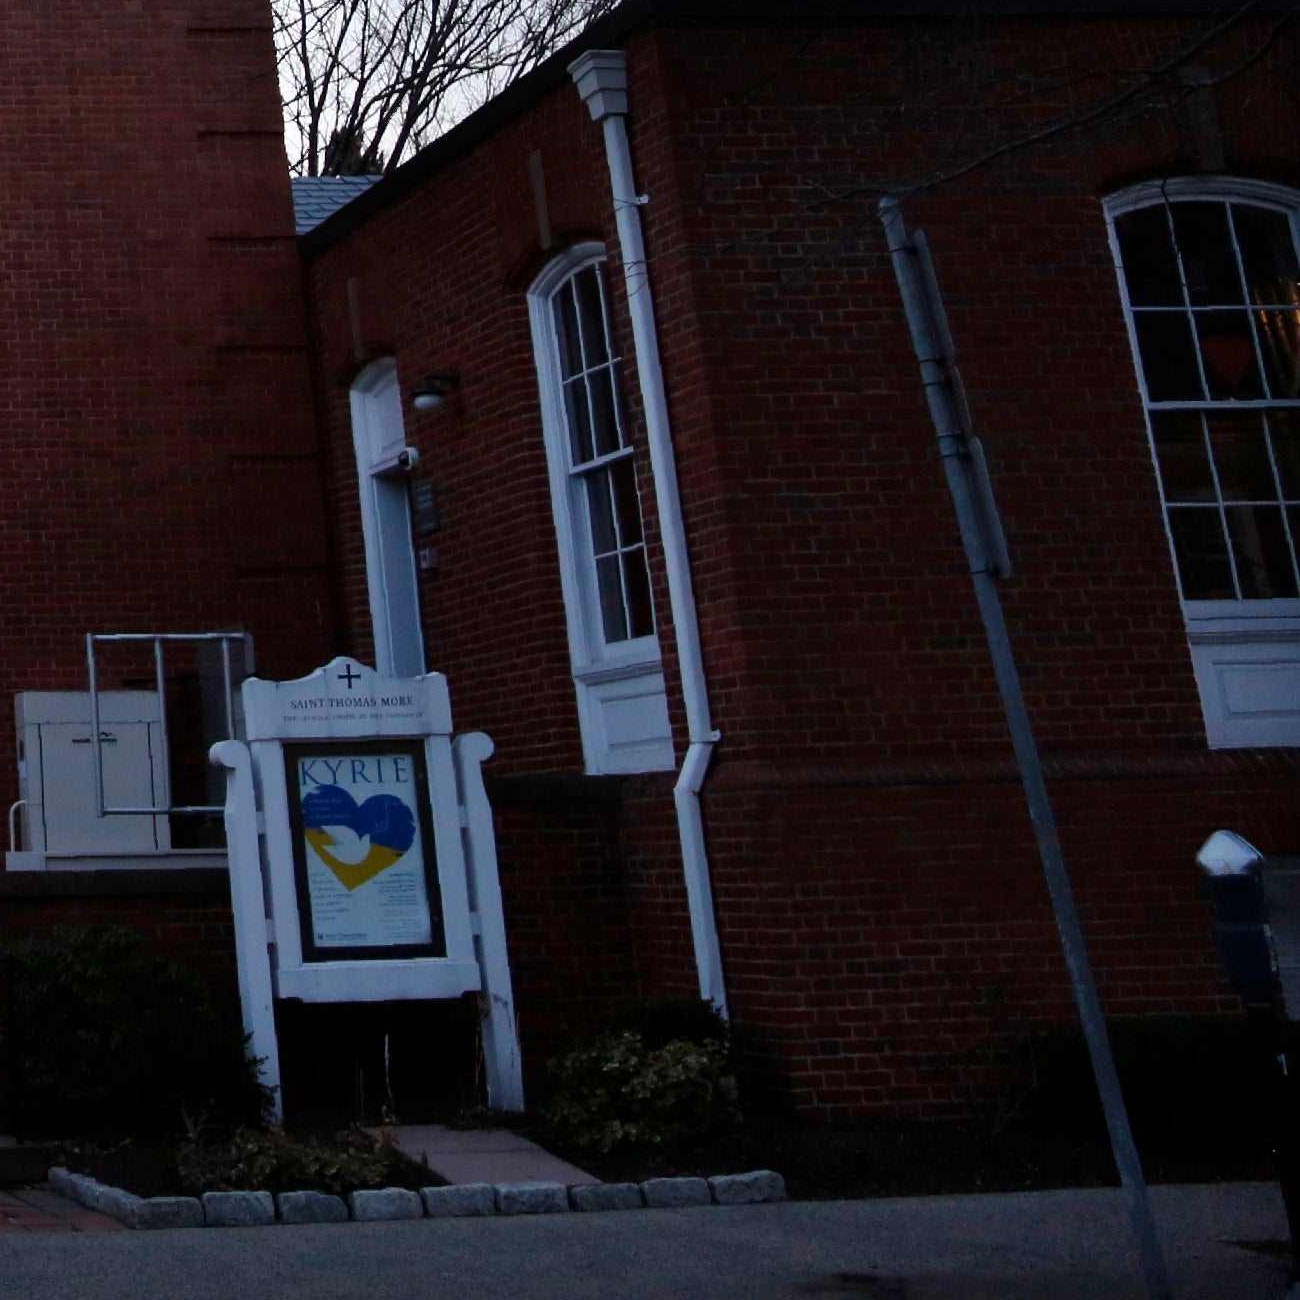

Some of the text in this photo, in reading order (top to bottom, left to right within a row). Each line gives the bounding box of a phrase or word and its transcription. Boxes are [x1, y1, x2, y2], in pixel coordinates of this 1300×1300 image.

[289, 694, 414, 709] SAINT THOMAS MORE
[300, 756, 409, 785] KYRIE
